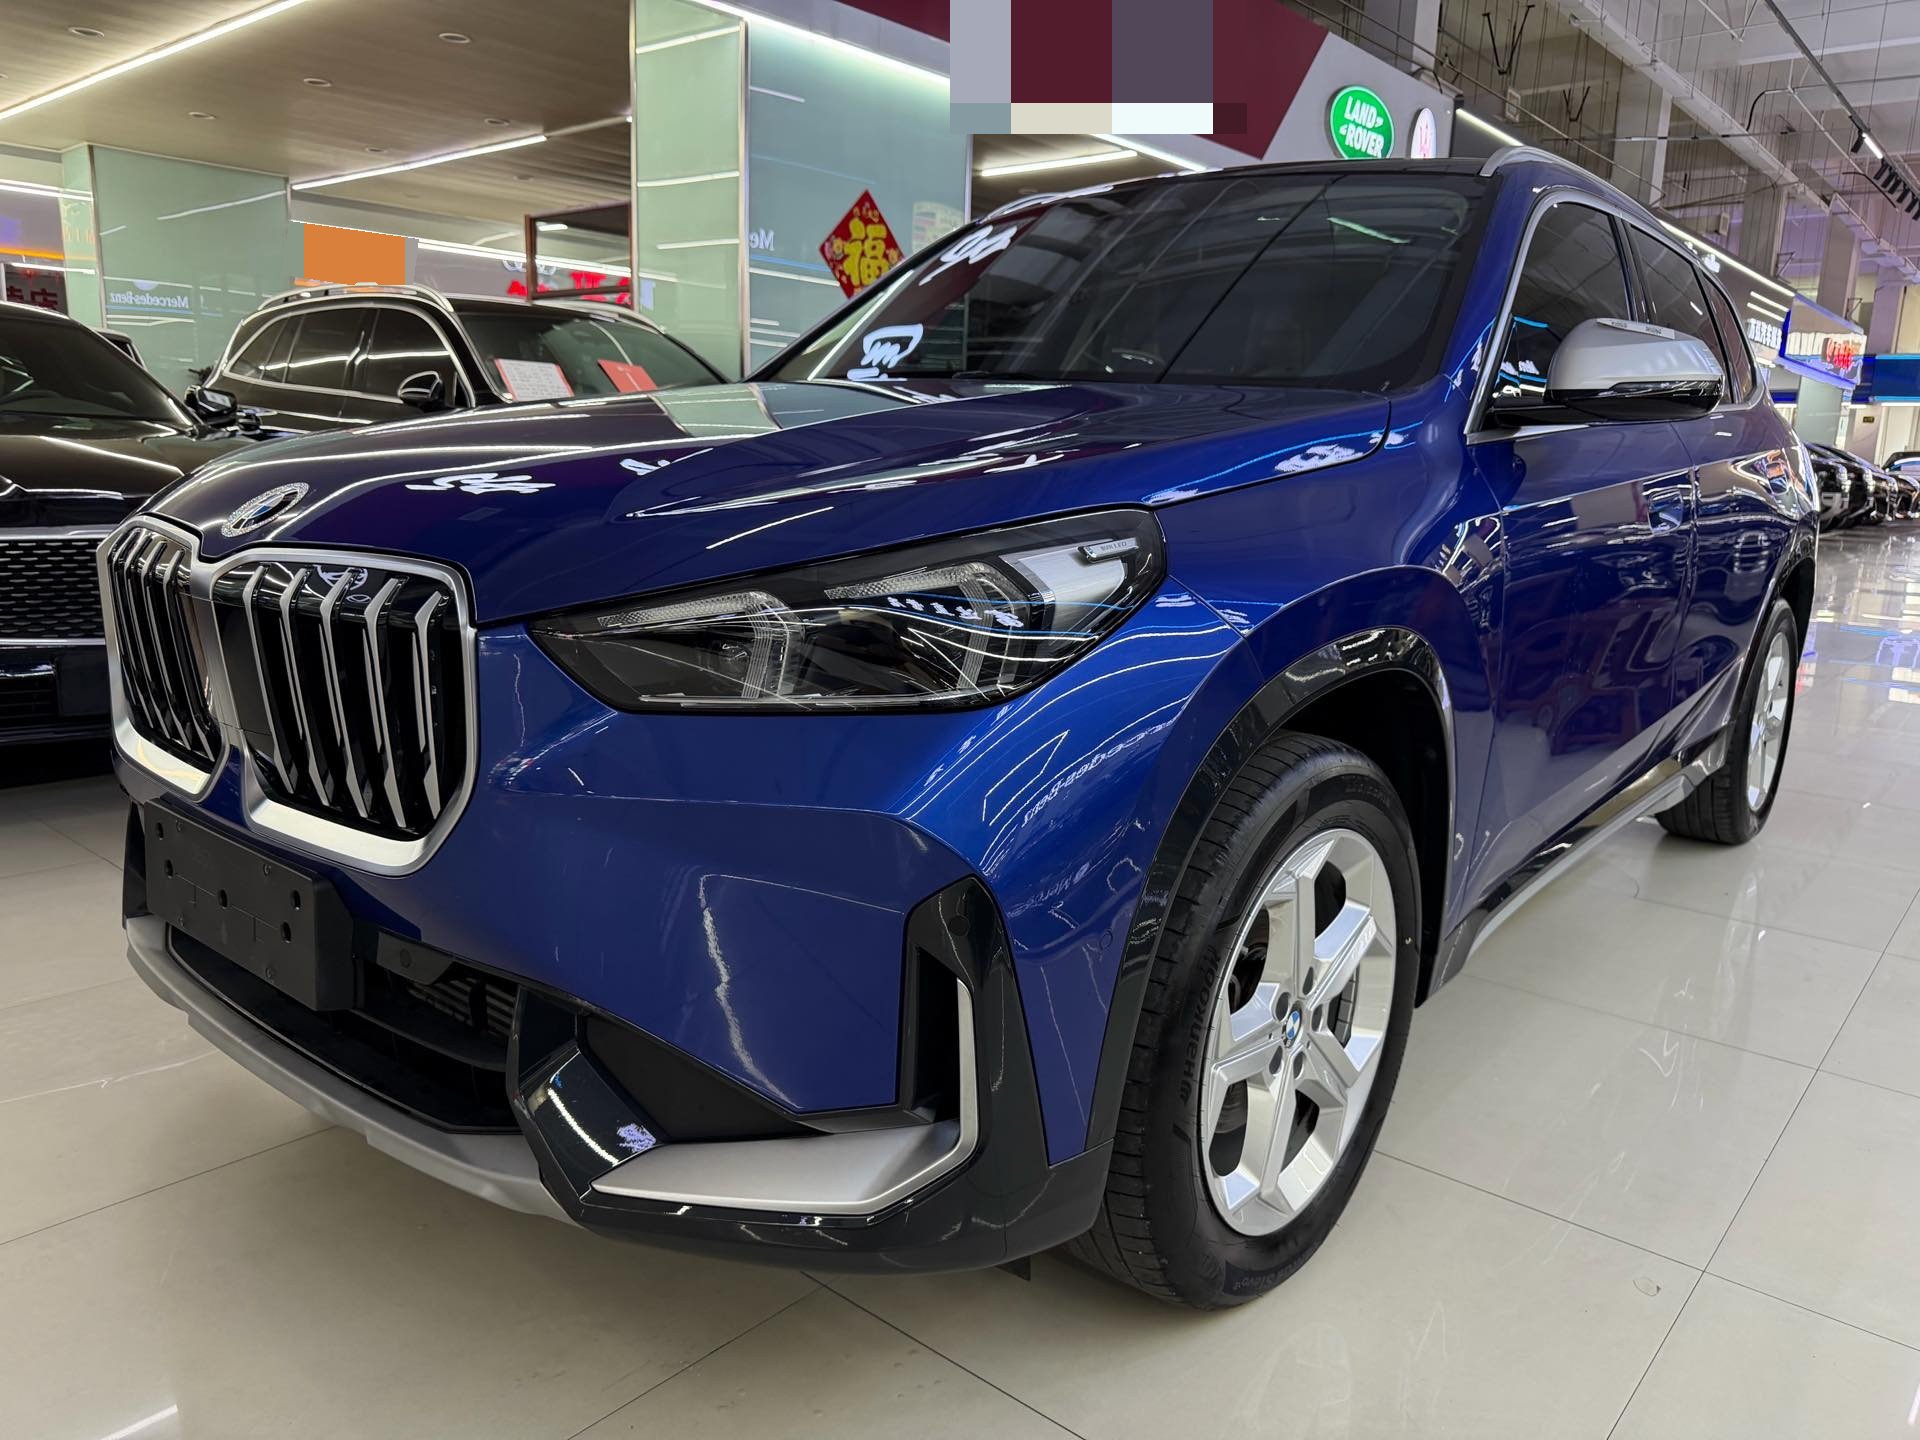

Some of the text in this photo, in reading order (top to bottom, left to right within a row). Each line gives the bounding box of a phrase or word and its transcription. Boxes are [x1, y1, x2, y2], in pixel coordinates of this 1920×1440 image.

[1344, 96, 1378, 129] LAND
[1344, 124, 1385, 157] ROVER
[843, 217, 890, 286] 福
